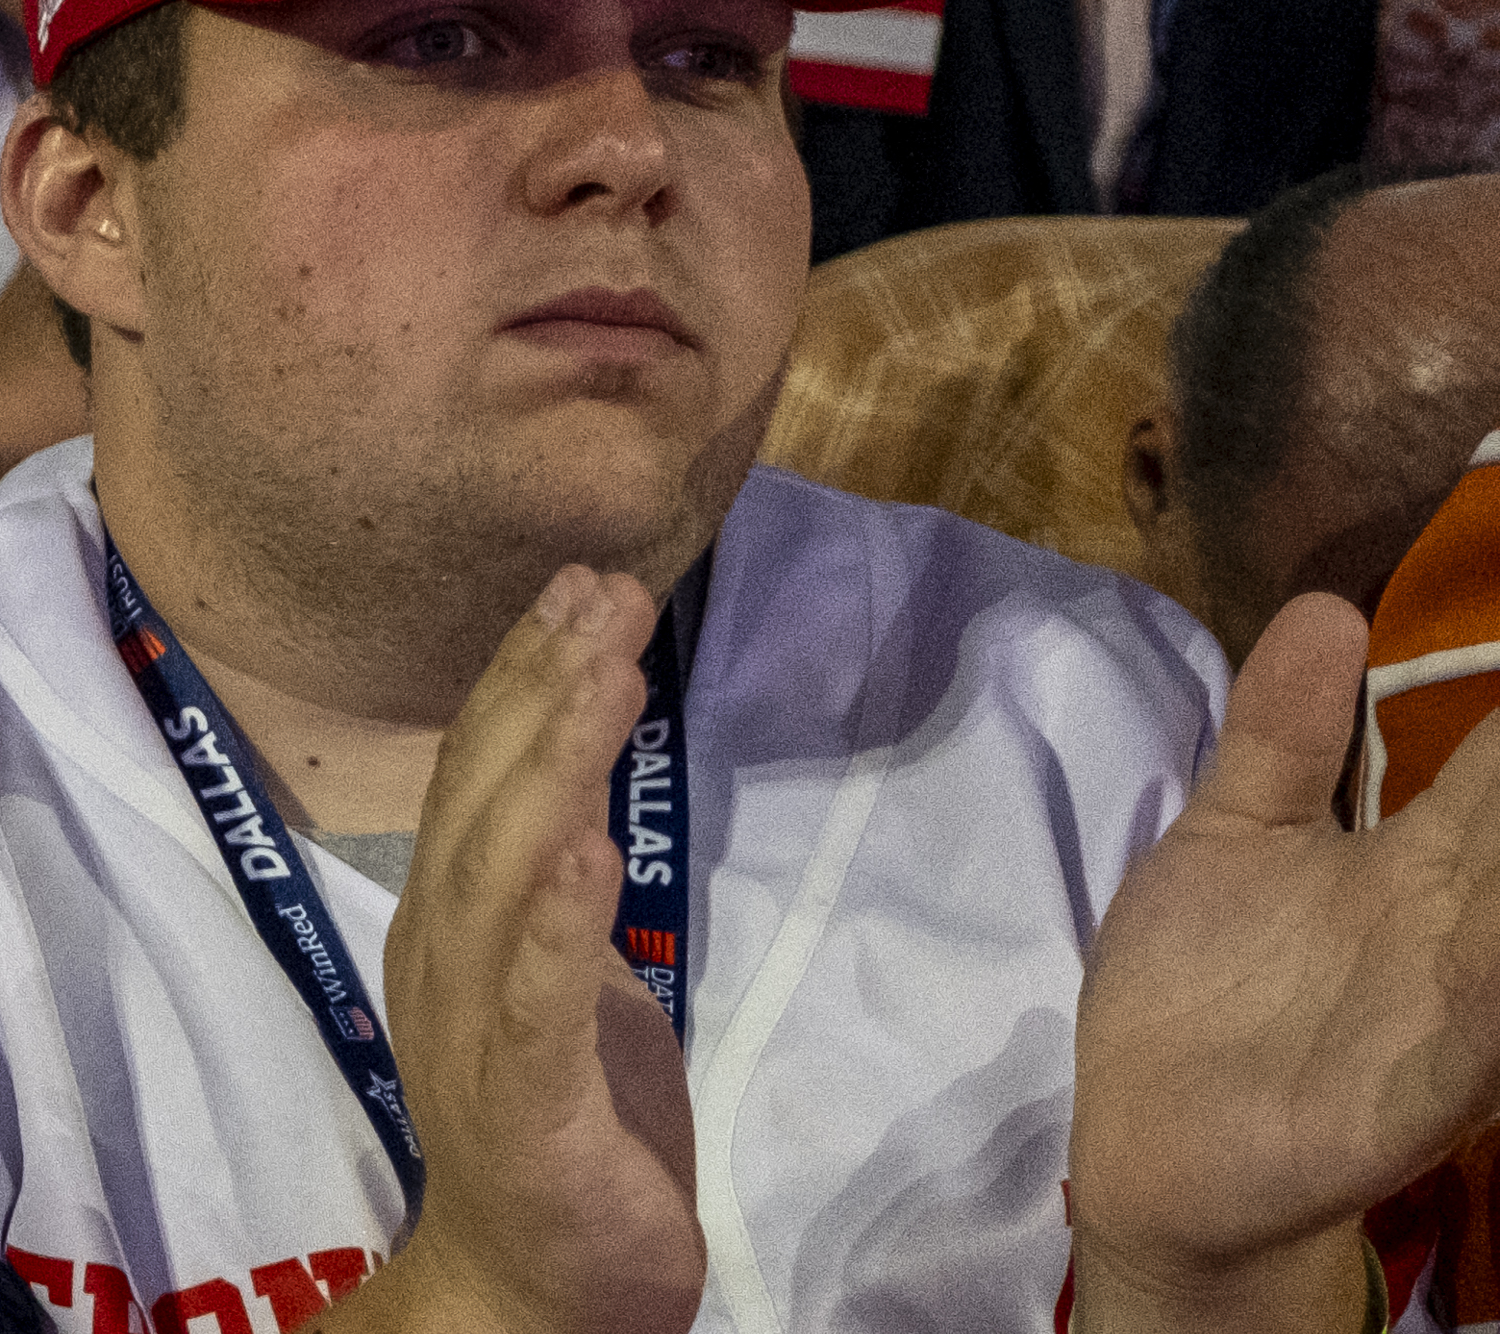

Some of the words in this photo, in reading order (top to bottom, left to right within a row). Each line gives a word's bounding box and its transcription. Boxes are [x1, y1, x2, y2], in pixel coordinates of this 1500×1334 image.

[164, 705, 291, 881] DALLAS
[628, 718, 672, 887] DALLAS
[276, 903, 347, 1003] WinRed
